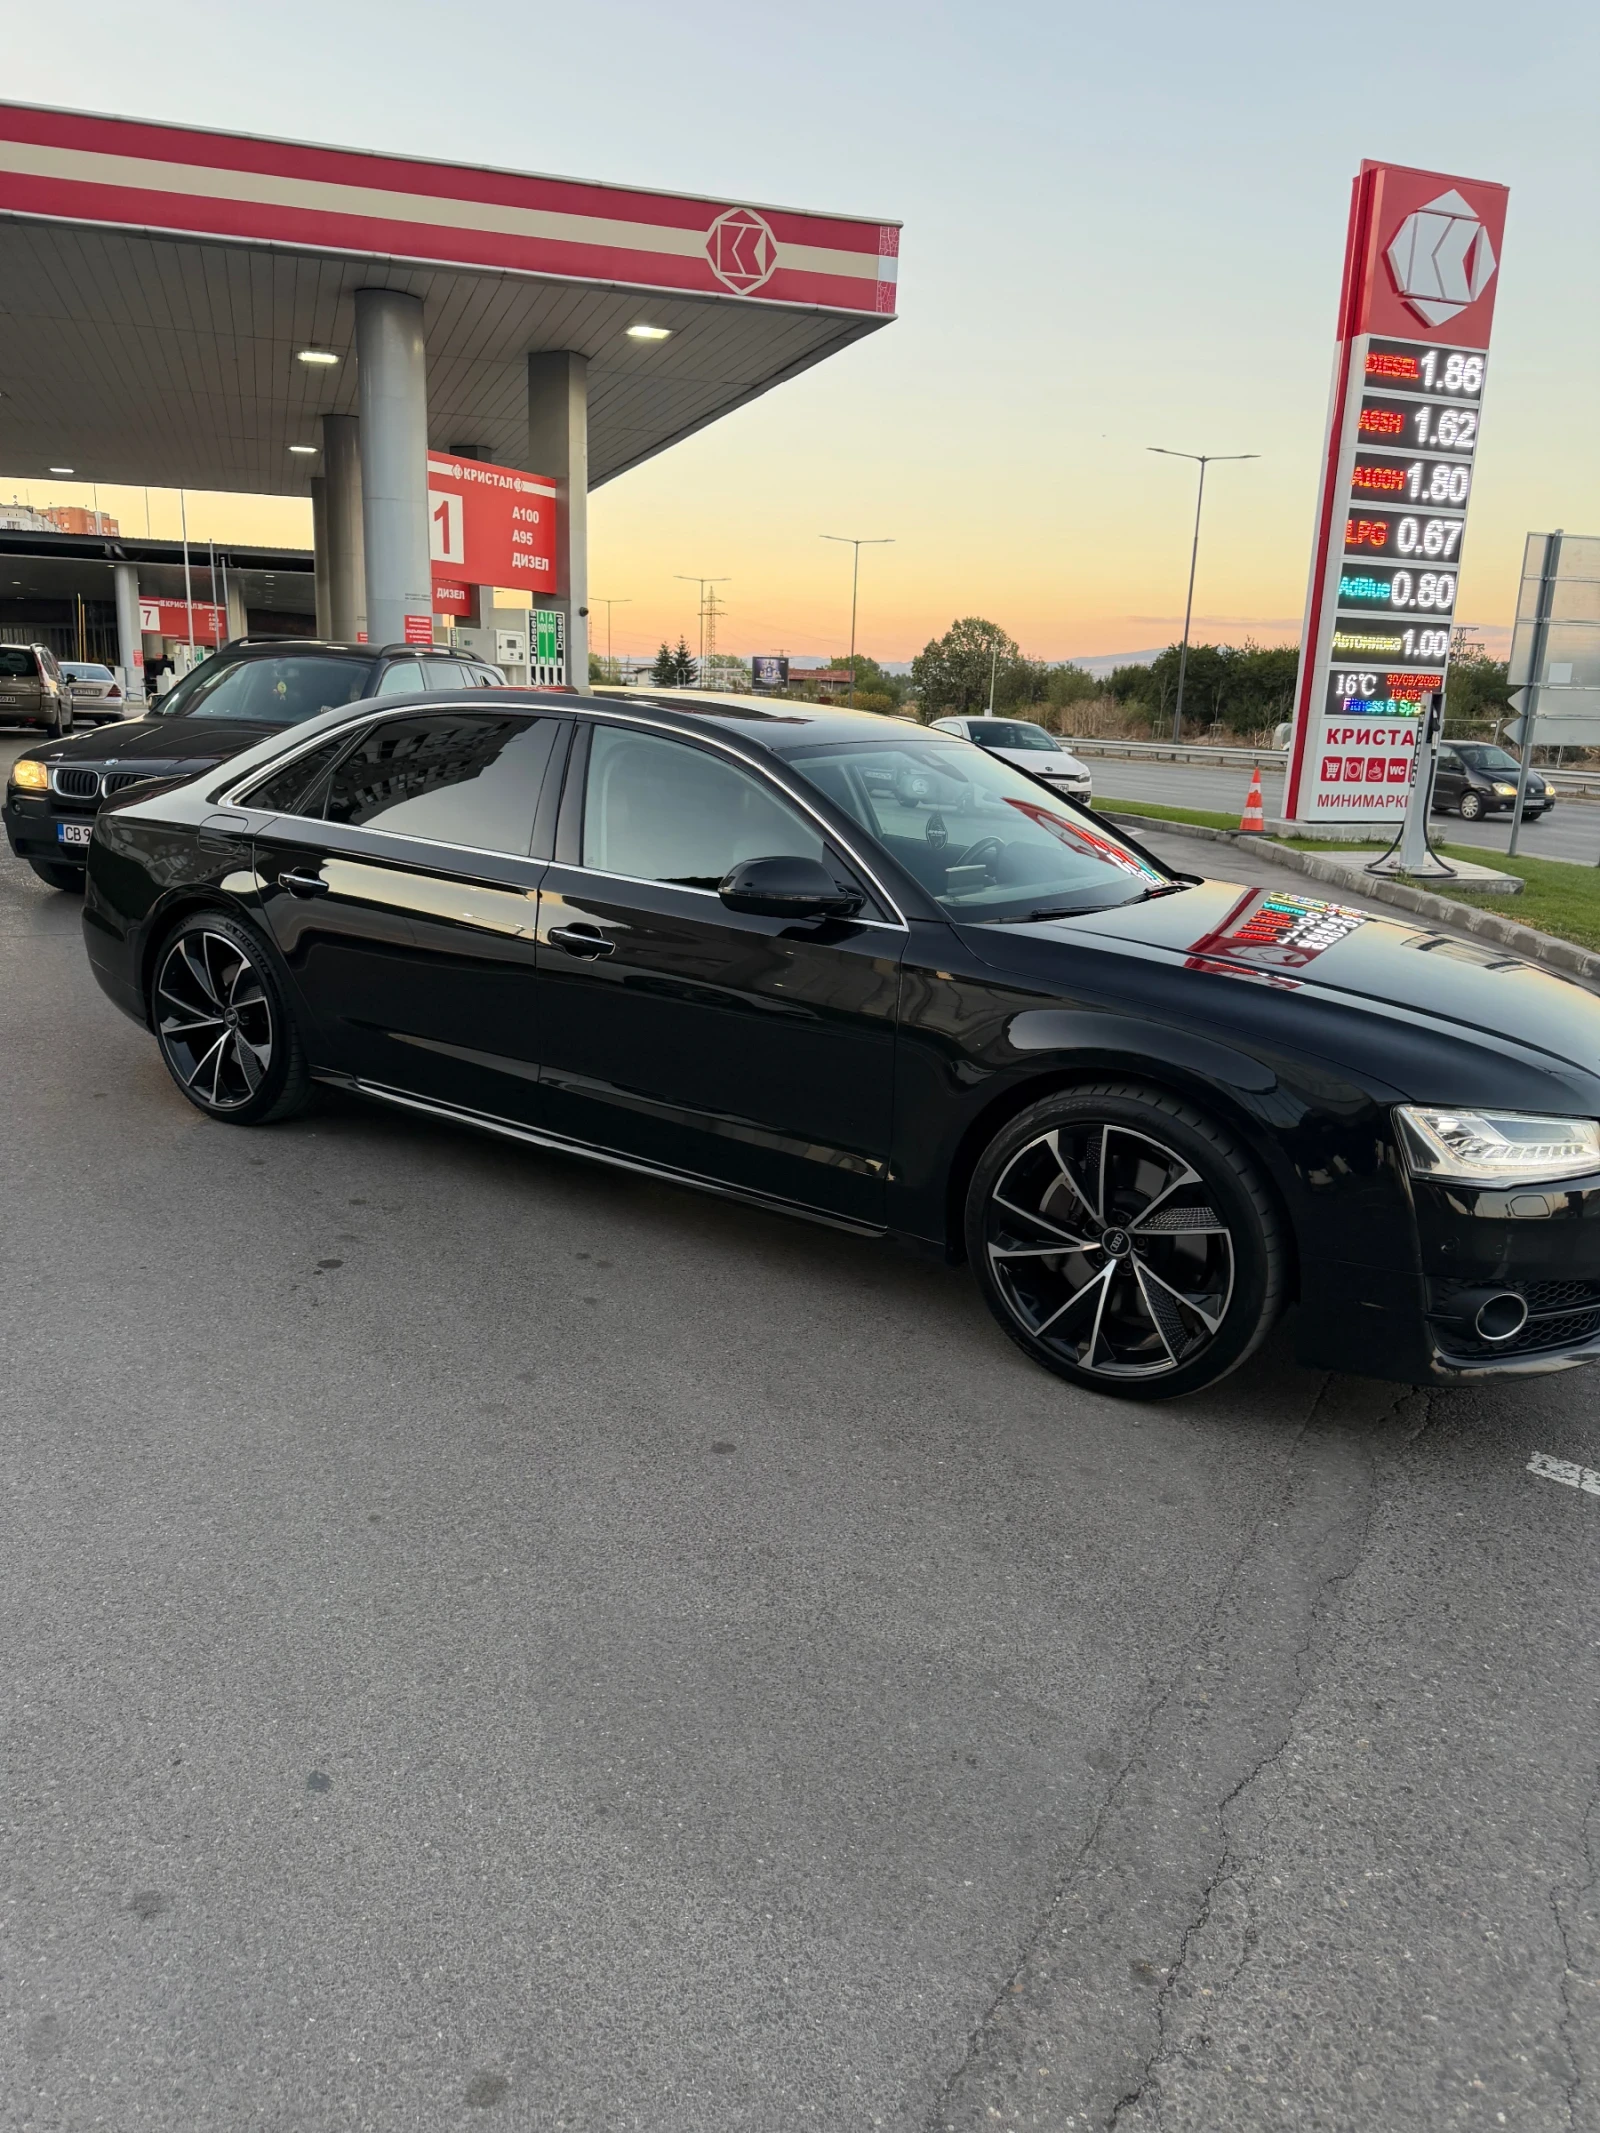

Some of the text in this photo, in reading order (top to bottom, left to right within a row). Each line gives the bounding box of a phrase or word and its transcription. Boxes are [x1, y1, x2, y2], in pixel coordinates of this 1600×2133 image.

[1365, 350, 1484, 391] DIESEL 1.86
[1415, 406, 1476, 448] 1.62
[463, 467, 514, 490] КРИСТАЛ
[1407, 462, 1468, 502] 1.80
[433, 500, 451, 555] 1
[1345, 517, 1463, 555] LPG 0.67
[512, 552, 549, 571] ДИЗЕЛ
[436, 587, 465, 600] ДИЗЕЛ
[1338, 571, 1455, 608] AdBlue 0.80
[165, 600, 197, 610] КРИСТЛ
[143, 610, 152, 626] 7
[1403, 629, 1448, 657] 1.00
[1343, 698, 1422, 717] Fitness & Spa
[1326, 728, 1415, 746] КРИСТА
[1389, 765, 1405, 776] WC
[1317, 794, 1409, 809] МИНИМАРК
[66, 826, 81, 841] CB
